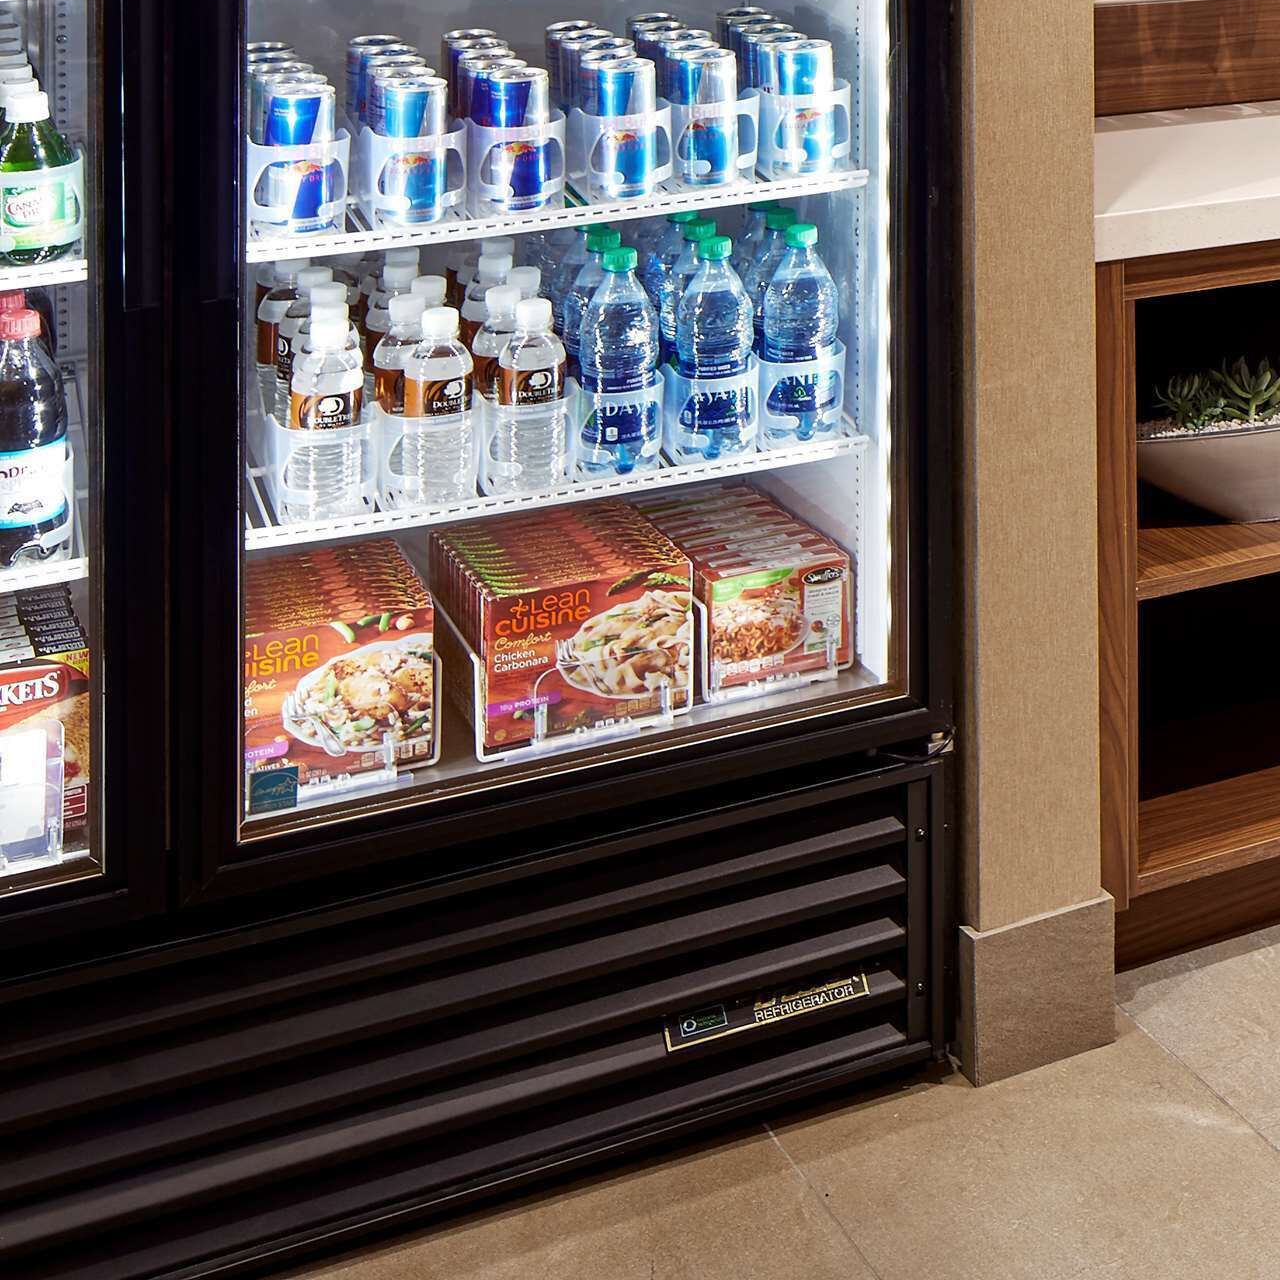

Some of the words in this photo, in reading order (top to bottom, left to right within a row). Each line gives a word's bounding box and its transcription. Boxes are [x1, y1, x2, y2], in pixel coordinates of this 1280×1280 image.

[531, 588, 591, 616] Lean
[253, 633, 319, 661] Lean
[494, 631, 552, 651] Comfort
[494, 649, 535, 664] Chicken
[494, 655, 549, 673] Carbonara
[0, 671, 60, 705] KETS
[754, 984, 855, 1023] REFRIGERATOR
